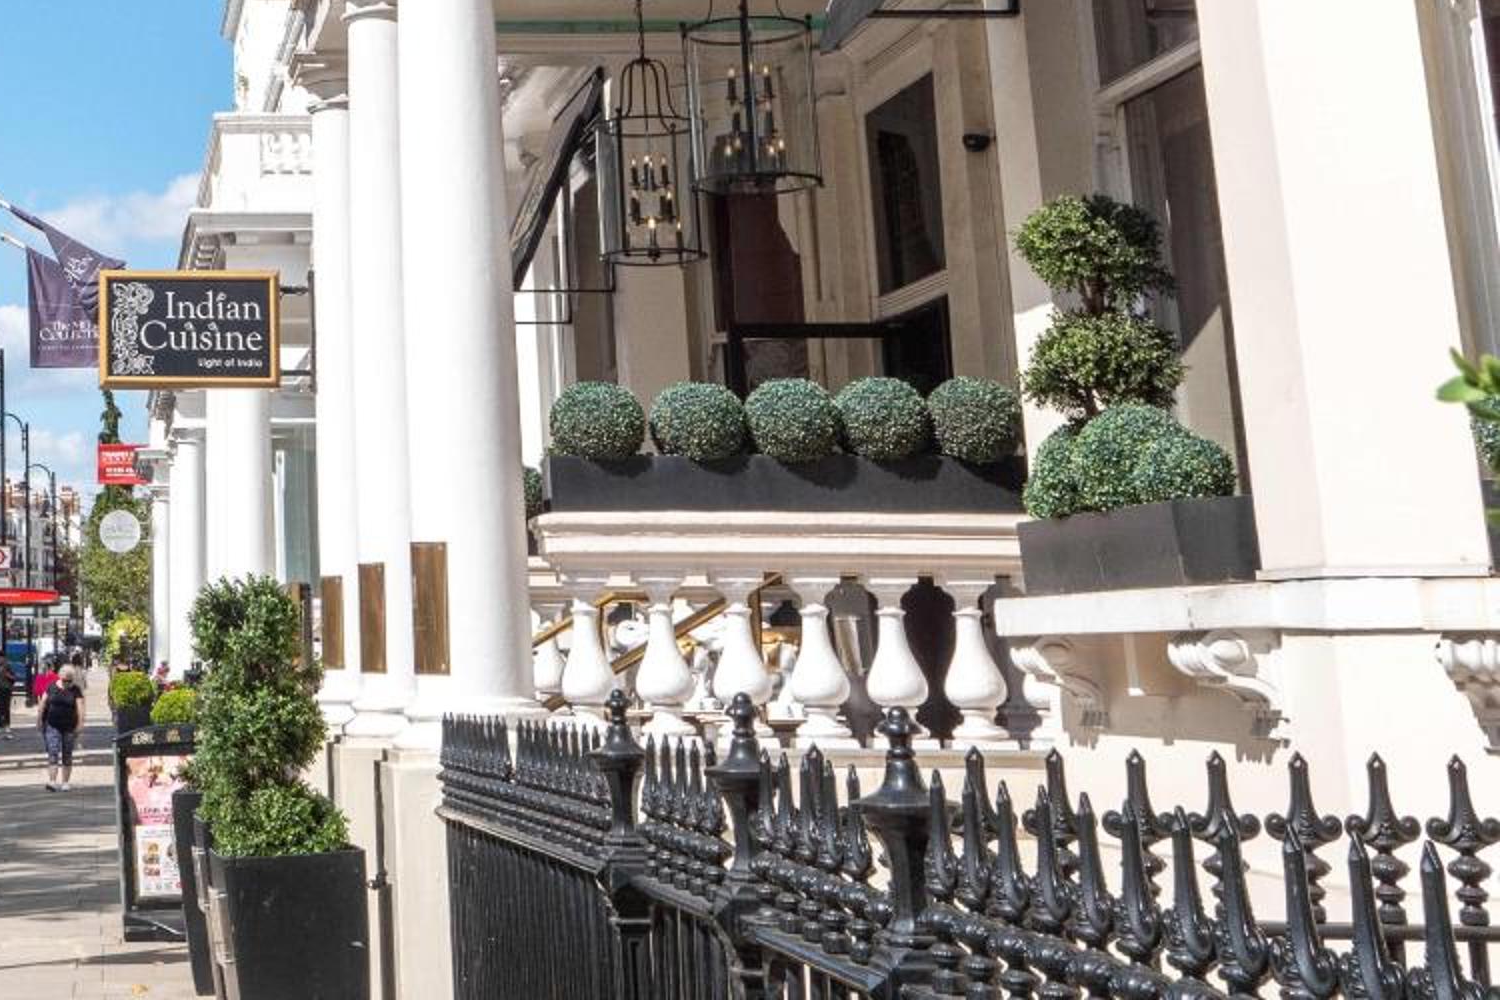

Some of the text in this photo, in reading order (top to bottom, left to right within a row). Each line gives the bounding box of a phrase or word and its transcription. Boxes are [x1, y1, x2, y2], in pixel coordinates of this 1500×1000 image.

[164, 290, 261, 320] Indian
[140, 319, 263, 351] Cuisine
[198, 357, 263, 369] Light of India
